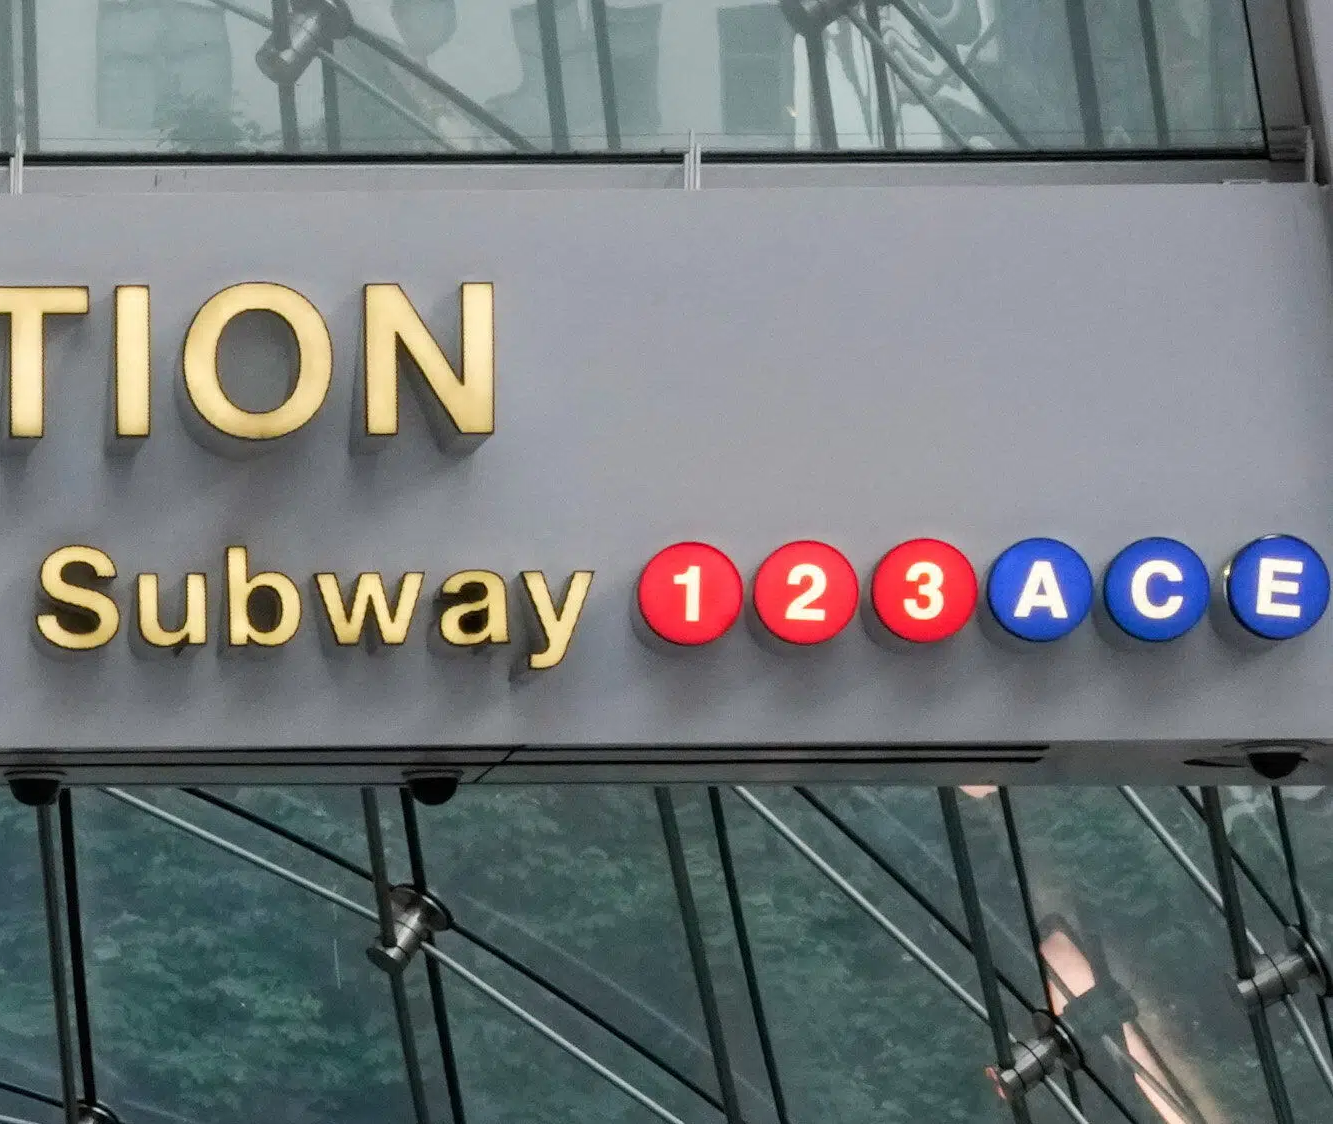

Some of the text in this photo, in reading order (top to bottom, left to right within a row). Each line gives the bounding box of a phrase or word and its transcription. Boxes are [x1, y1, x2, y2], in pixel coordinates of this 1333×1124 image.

[36, 545, 595, 669] Subway
[673, 559, 1305, 622] 1 2 3 A C E
